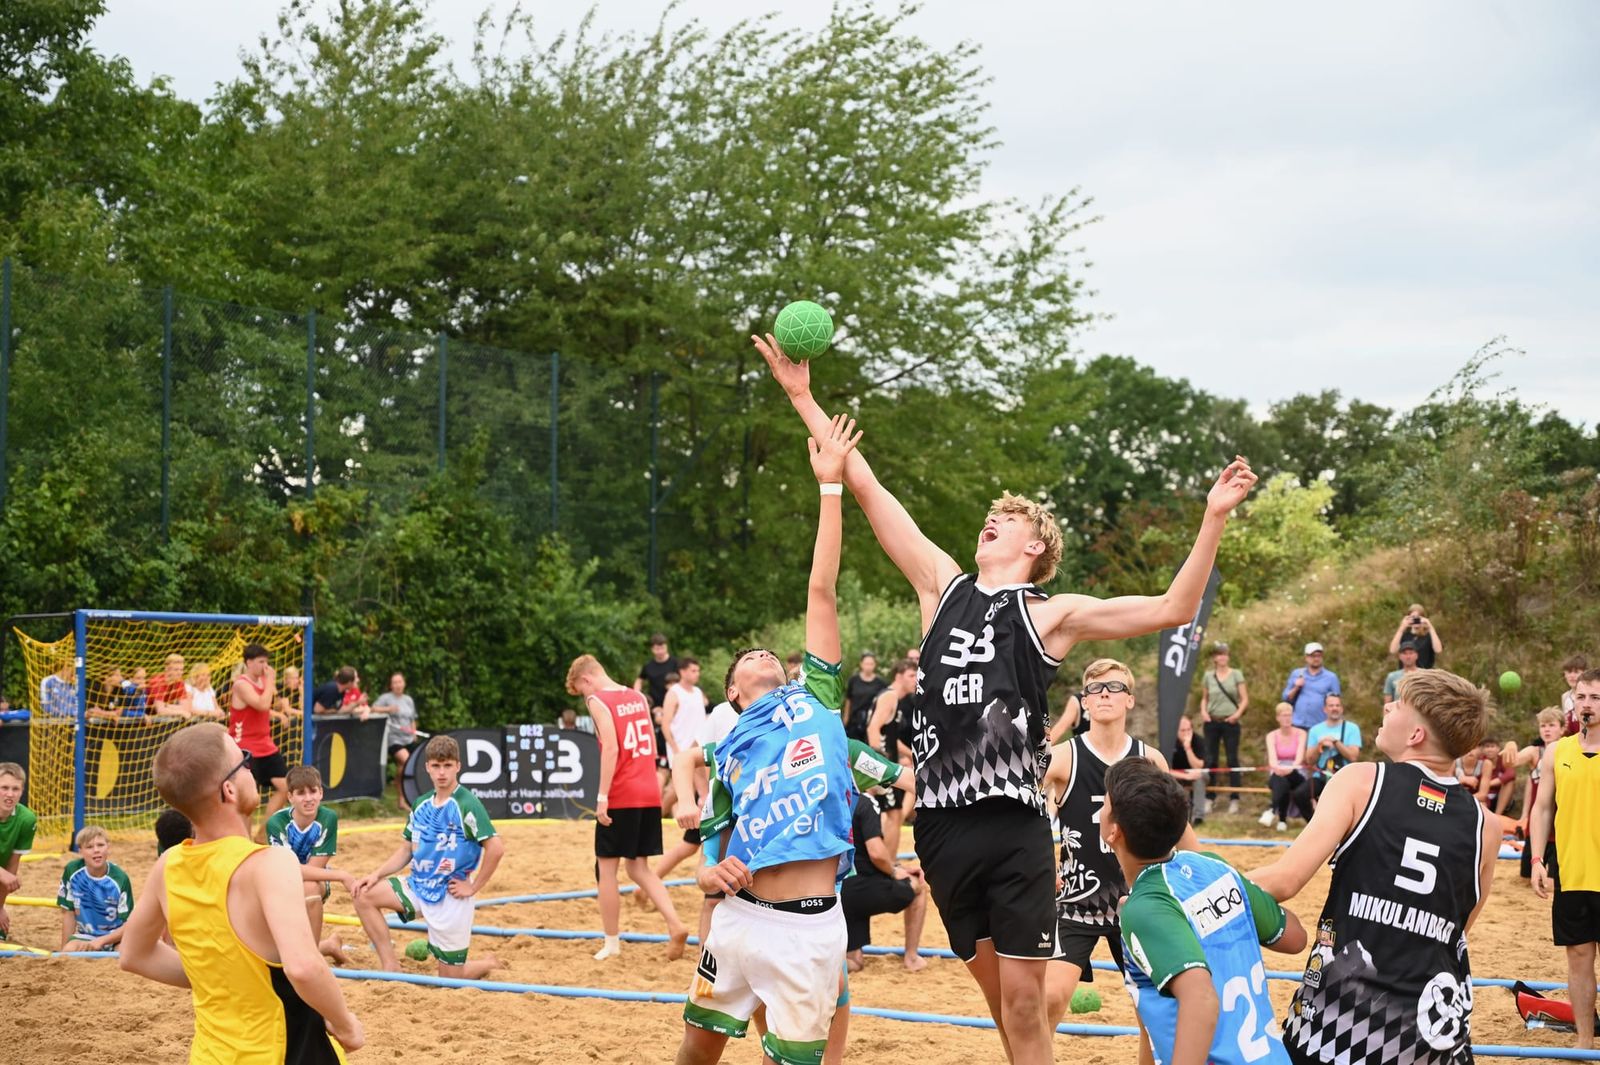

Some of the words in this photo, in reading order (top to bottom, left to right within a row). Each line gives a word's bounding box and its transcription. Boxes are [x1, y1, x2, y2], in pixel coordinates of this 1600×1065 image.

[940, 624, 995, 668] 33
[943, 673, 984, 705] GER
[771, 693, 814, 733] 15
[623, 718, 653, 759] 45
[459, 739, 583, 784] DB
[1416, 796, 1446, 815] GER
[435, 832, 457, 852] 24
[1393, 836, 1441, 896] 5
[105, 906, 117, 922] 3
[800, 898, 824, 908] BOSS
